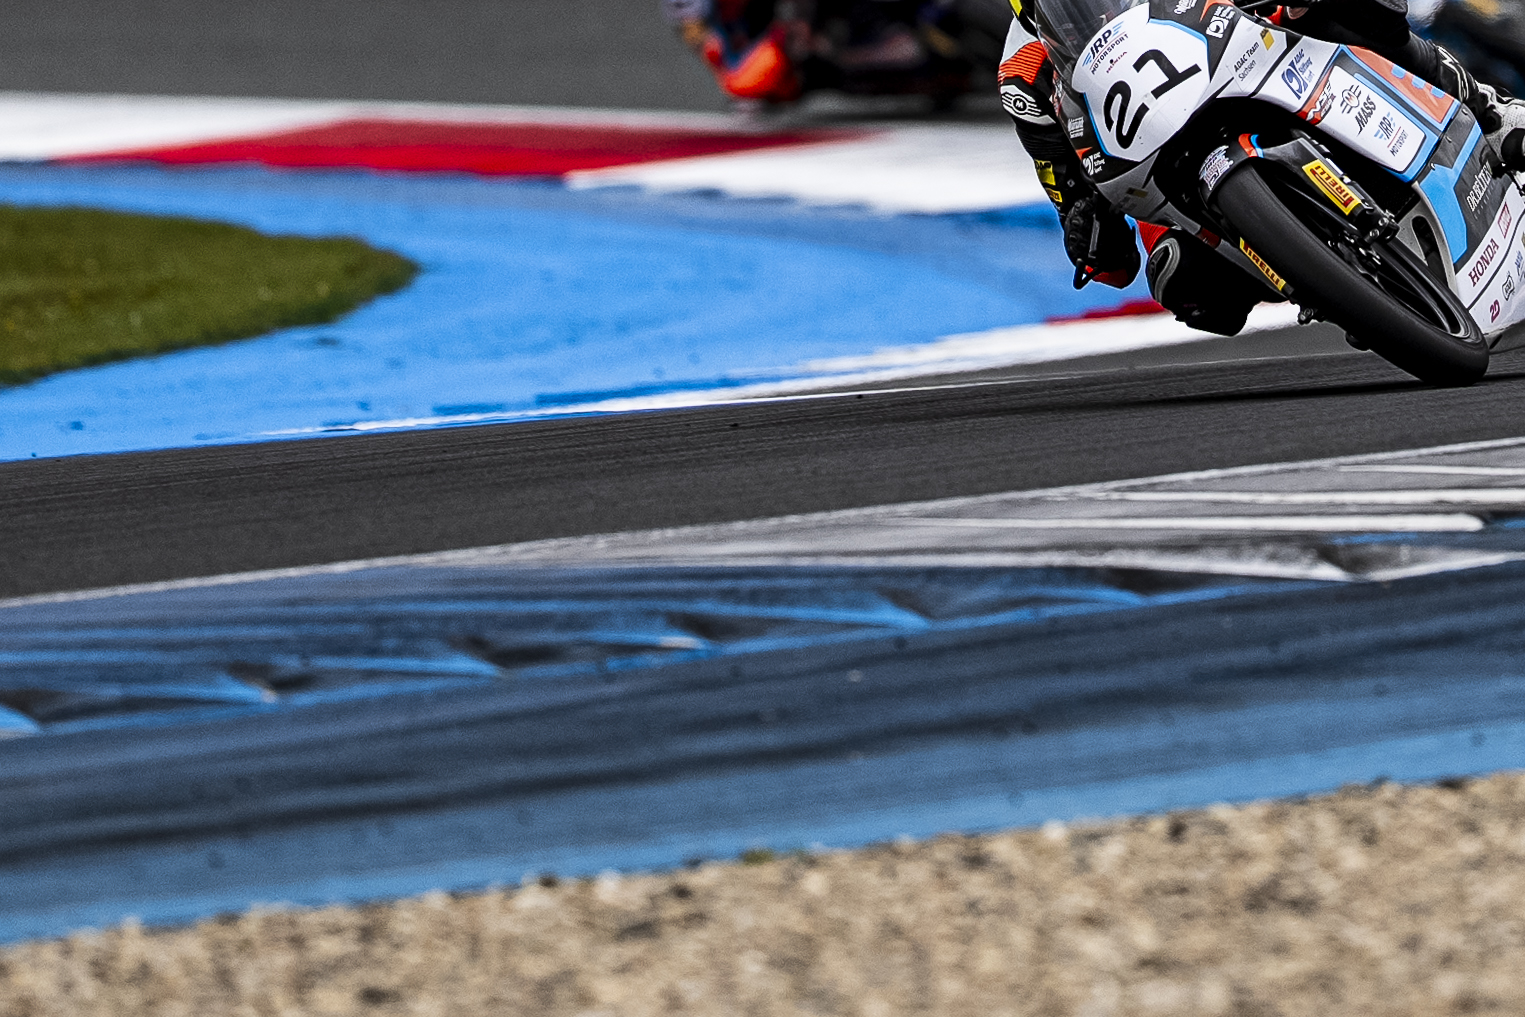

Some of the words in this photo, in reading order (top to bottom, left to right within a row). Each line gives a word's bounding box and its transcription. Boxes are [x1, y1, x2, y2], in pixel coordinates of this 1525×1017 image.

[1089, 29, 1112, 60] JRP
[1090, 33, 1130, 75] MOTORSPORT
[1233, 53, 1248, 73] ADAC
[1246, 42, 1260, 58] Team
[1238, 59, 1257, 82] Sachsen
[1103, 48, 1202, 150] 21
[1355, 94, 1377, 136] MASS
[1310, 165, 1354, 208] PIRELLI
[1468, 238, 1500, 287] HONDA
